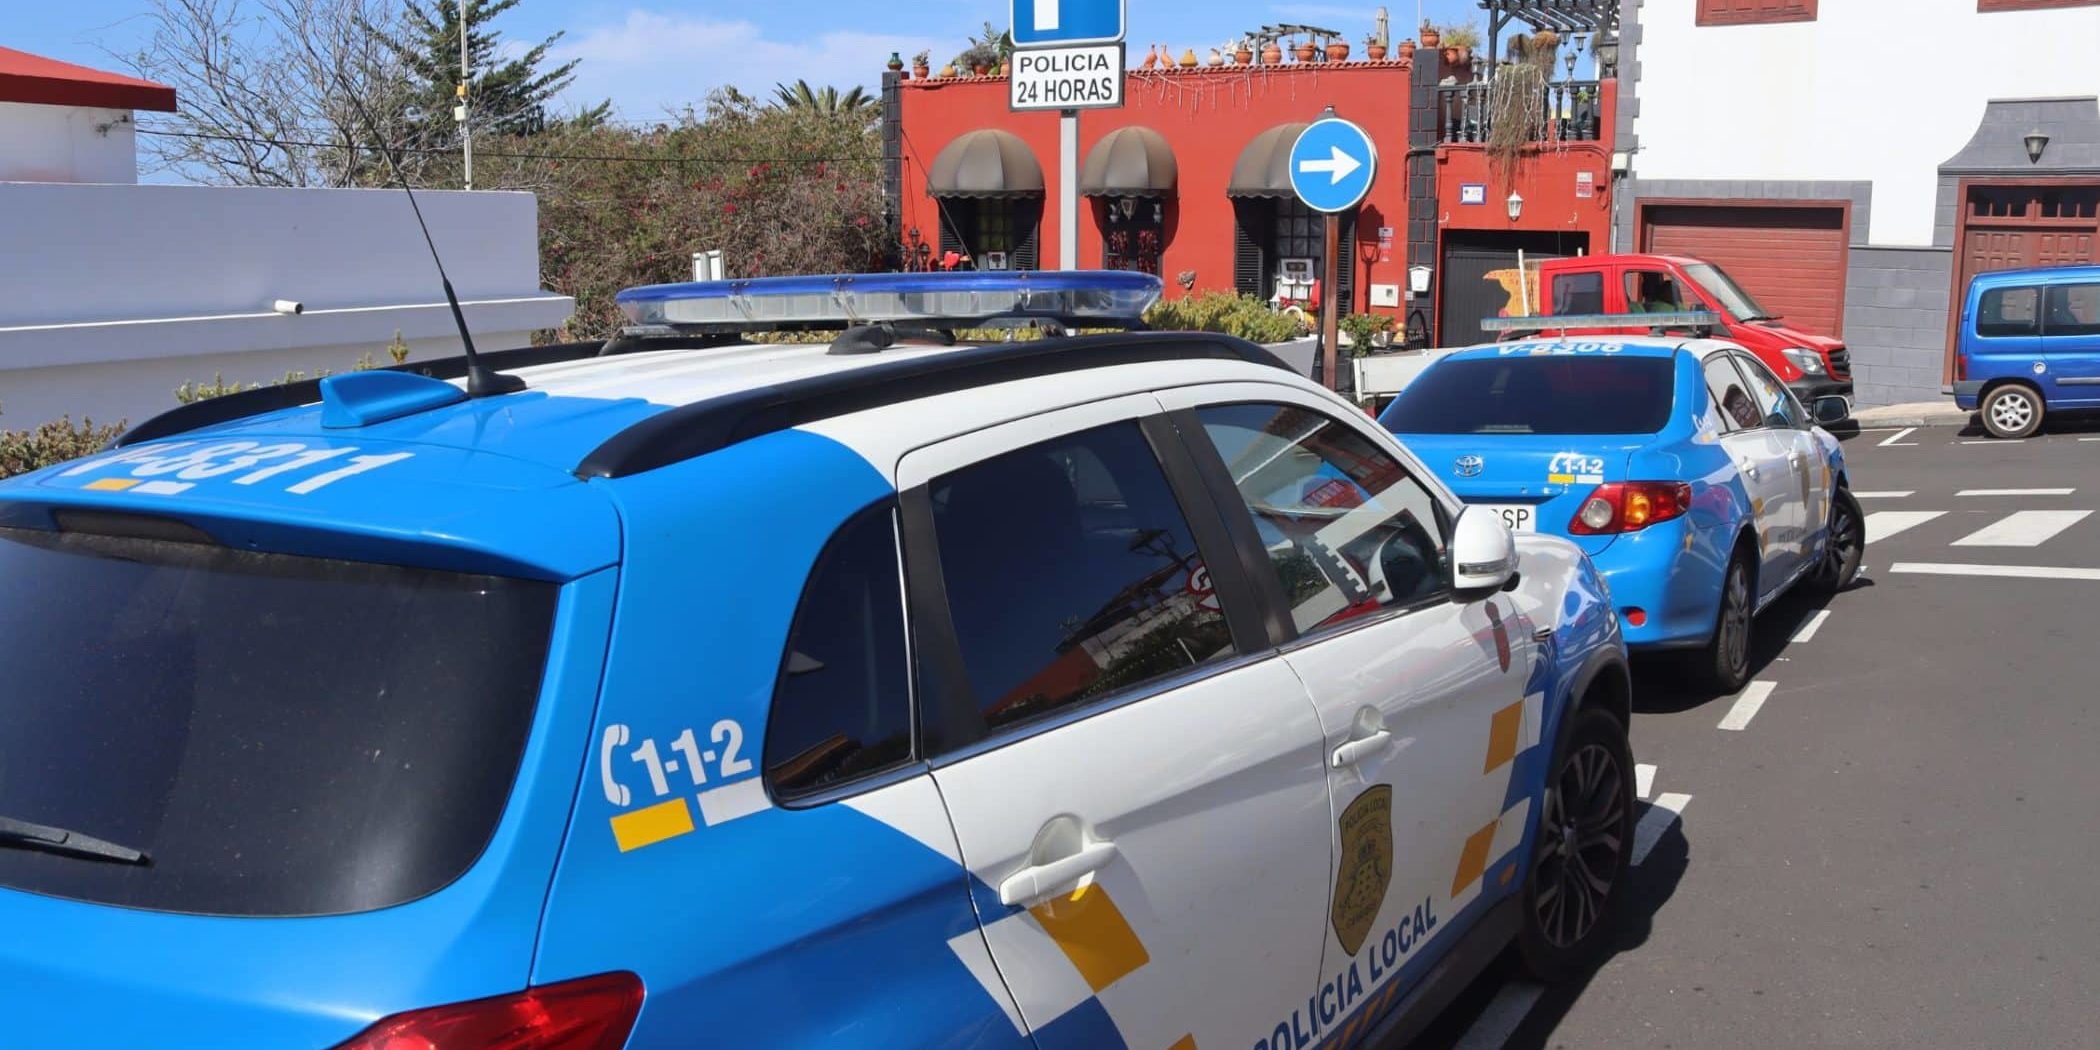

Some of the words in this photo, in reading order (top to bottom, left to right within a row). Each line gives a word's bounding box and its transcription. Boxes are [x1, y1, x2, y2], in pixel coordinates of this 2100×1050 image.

[1020, 53, 1109, 73] POLICIA
[1018, 81, 1038, 103] 24
[1045, 77, 1112, 102] HORAS
[58, 441, 415, 494] V-8311
[1563, 458, 1603, 473] 1-1-2
[631, 720, 753, 796] 1-1-2
[1254, 961, 1363, 1050] OLICIA
[1369, 896, 1436, 983] LOCAL
